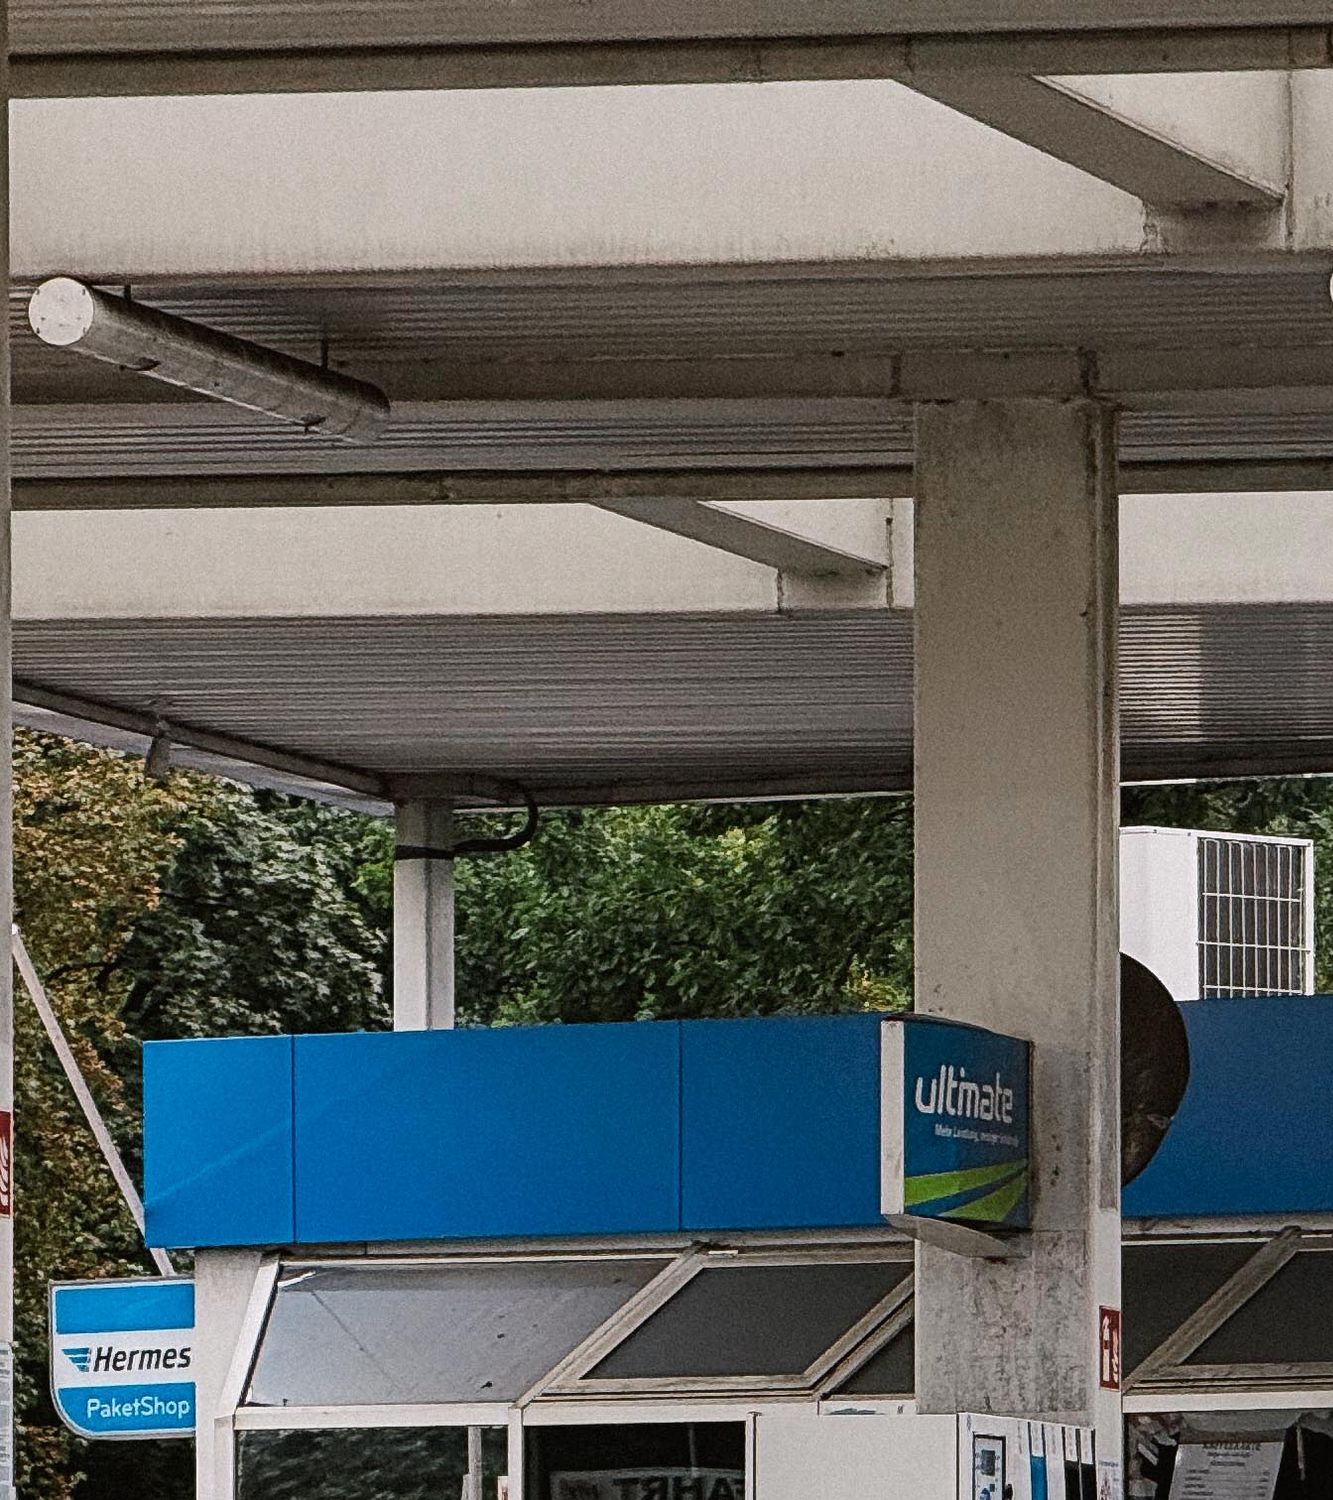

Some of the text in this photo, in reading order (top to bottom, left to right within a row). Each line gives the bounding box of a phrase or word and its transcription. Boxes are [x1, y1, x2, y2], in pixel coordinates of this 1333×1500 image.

[914, 1063, 1014, 1124] ultimate
[92, 1346, 192, 1372] Hermes
[86, 1396, 190, 1419] PaketShop
